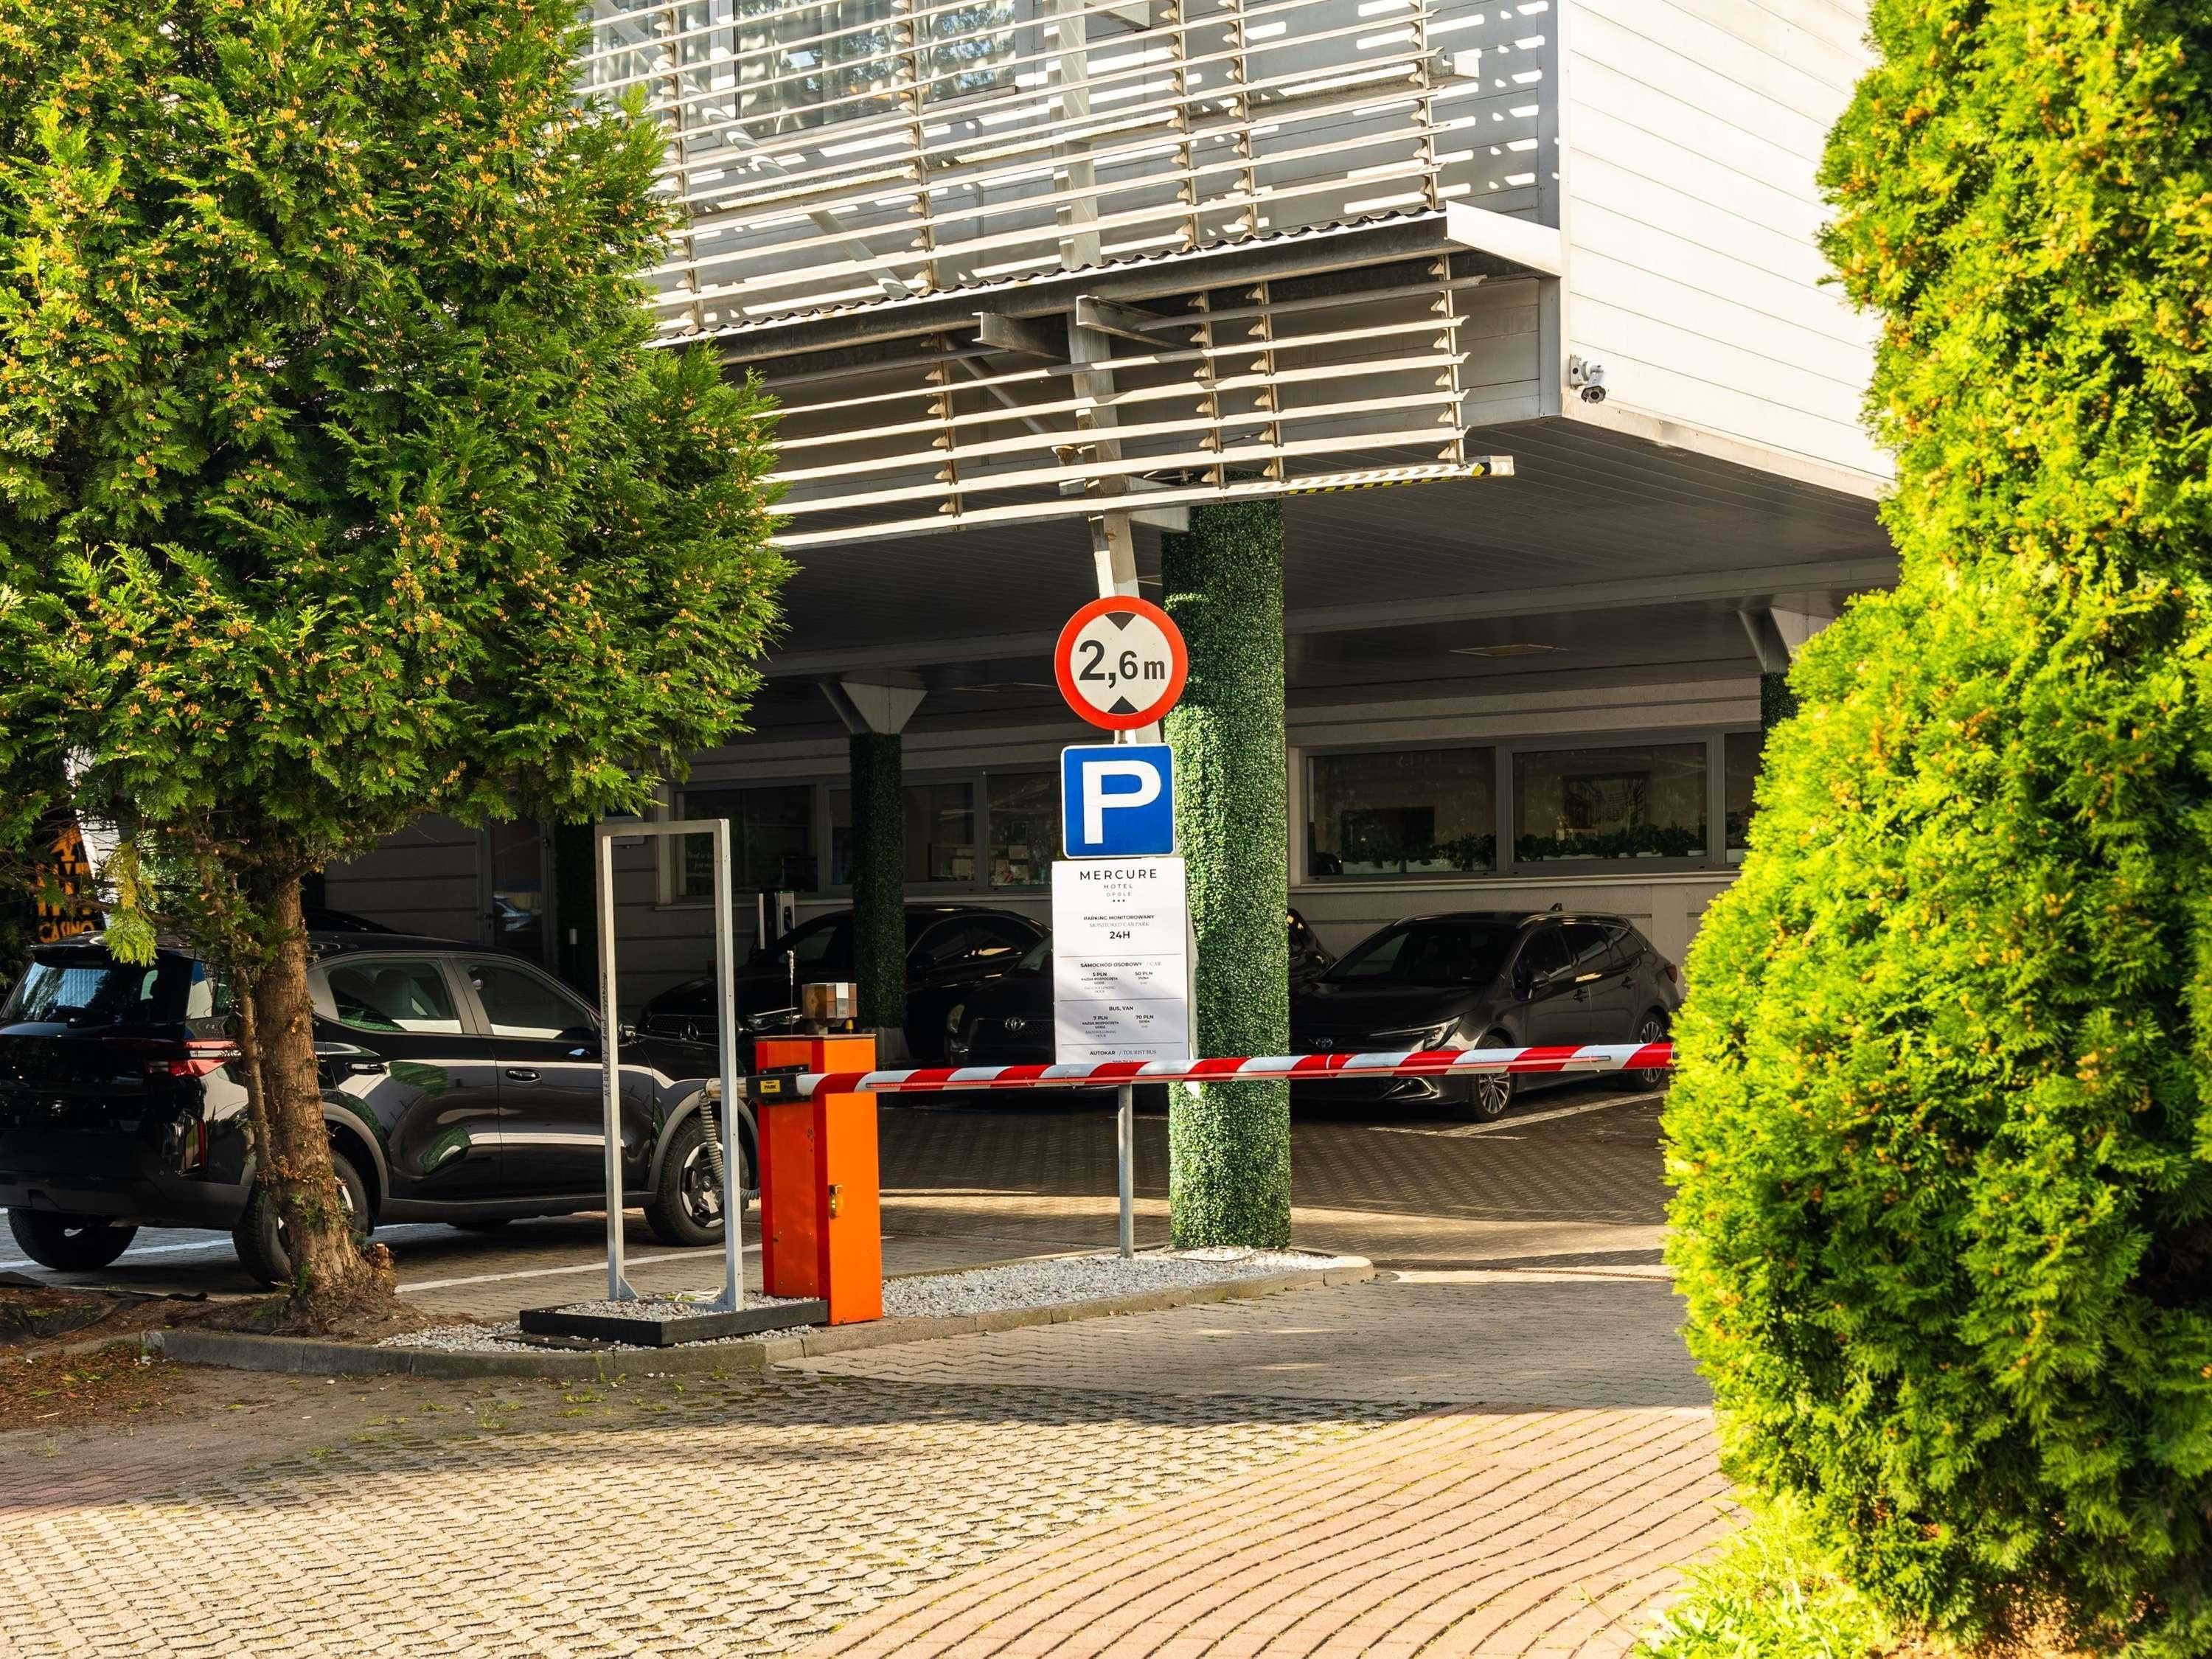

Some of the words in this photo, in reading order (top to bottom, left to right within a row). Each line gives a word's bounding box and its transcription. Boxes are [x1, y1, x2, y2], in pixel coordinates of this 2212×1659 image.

[1082, 759, 1161, 844] P
[1079, 869, 1158, 880] MERCURE
[1109, 931, 1130, 939] 24H
